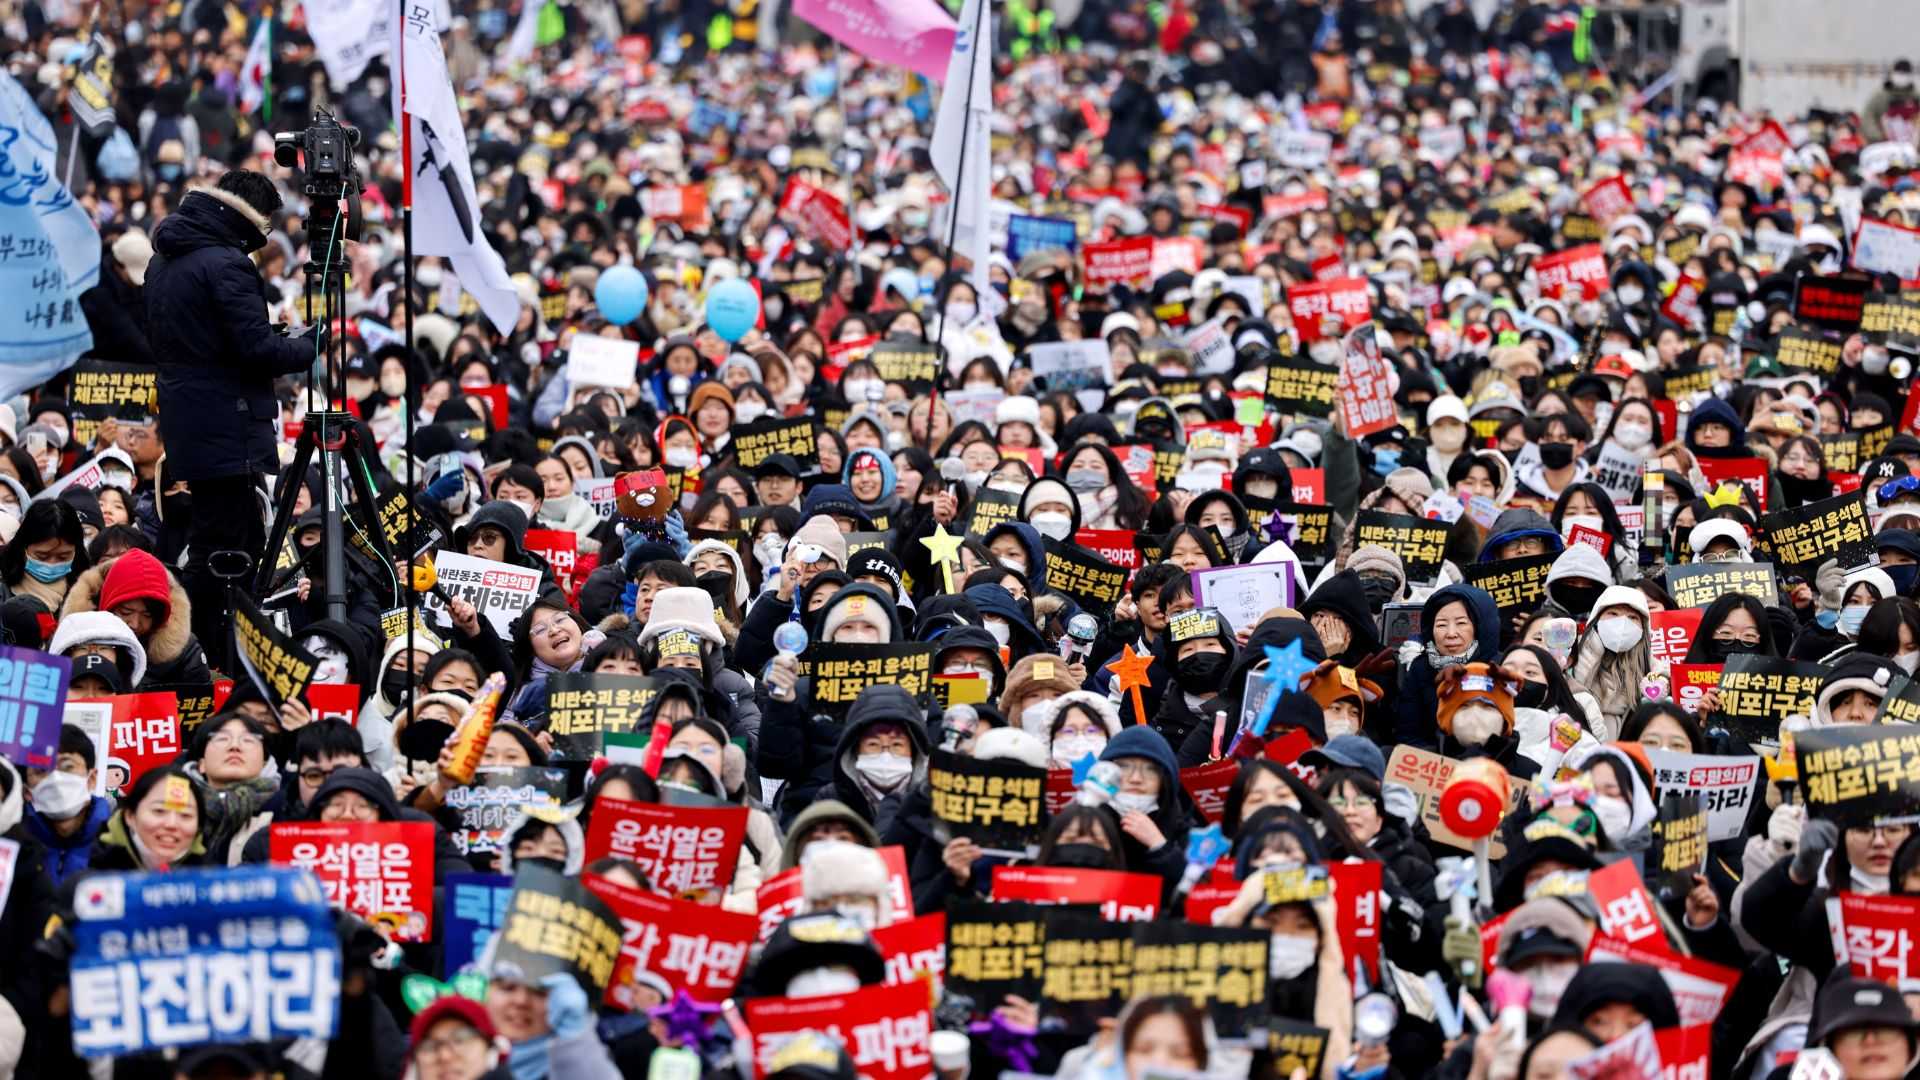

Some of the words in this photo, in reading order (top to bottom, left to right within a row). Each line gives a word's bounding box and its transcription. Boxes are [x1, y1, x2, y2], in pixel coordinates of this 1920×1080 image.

[1359, 525, 1411, 542] 내란수괴
[1411, 528, 1447, 544] 윤석열
[1771, 513, 1826, 547] 내란수괴
[1825, 499, 1863, 528] 윤석열
[1776, 518, 1869, 567] 체포!구속!
[437, 567, 482, 584] 내란동조
[1087, 568, 1125, 587] 윤석열
[1473, 567, 1525, 592] 내란수괴
[1673, 571, 1728, 590] 내란수괴
[1730, 569, 1770, 584] 윤석열
[86, 655, 103, 669] P
[816, 659, 883, 680] 내란수괴
[884, 652, 930, 674] 윤석열
[551, 689, 613, 710] 내란수괴
[1722, 671, 1783, 693] 내란수괴
[113, 715, 177, 756] 파면
[1804, 739, 1881, 774] 내란수괴
[931, 768, 985, 796] 내란수괴
[986, 775, 1041, 798] 윤석열
[609, 819, 726, 860] 윤석열은
[288, 842, 413, 882] 윤석열은
[327, 880, 414, 918] 각체포
[661, 932, 749, 990] 파면
[1845, 924, 1914, 980] 즉각
[69, 945, 342, 1050] 퇴진하라
[851, 1010, 933, 1072] 파면
